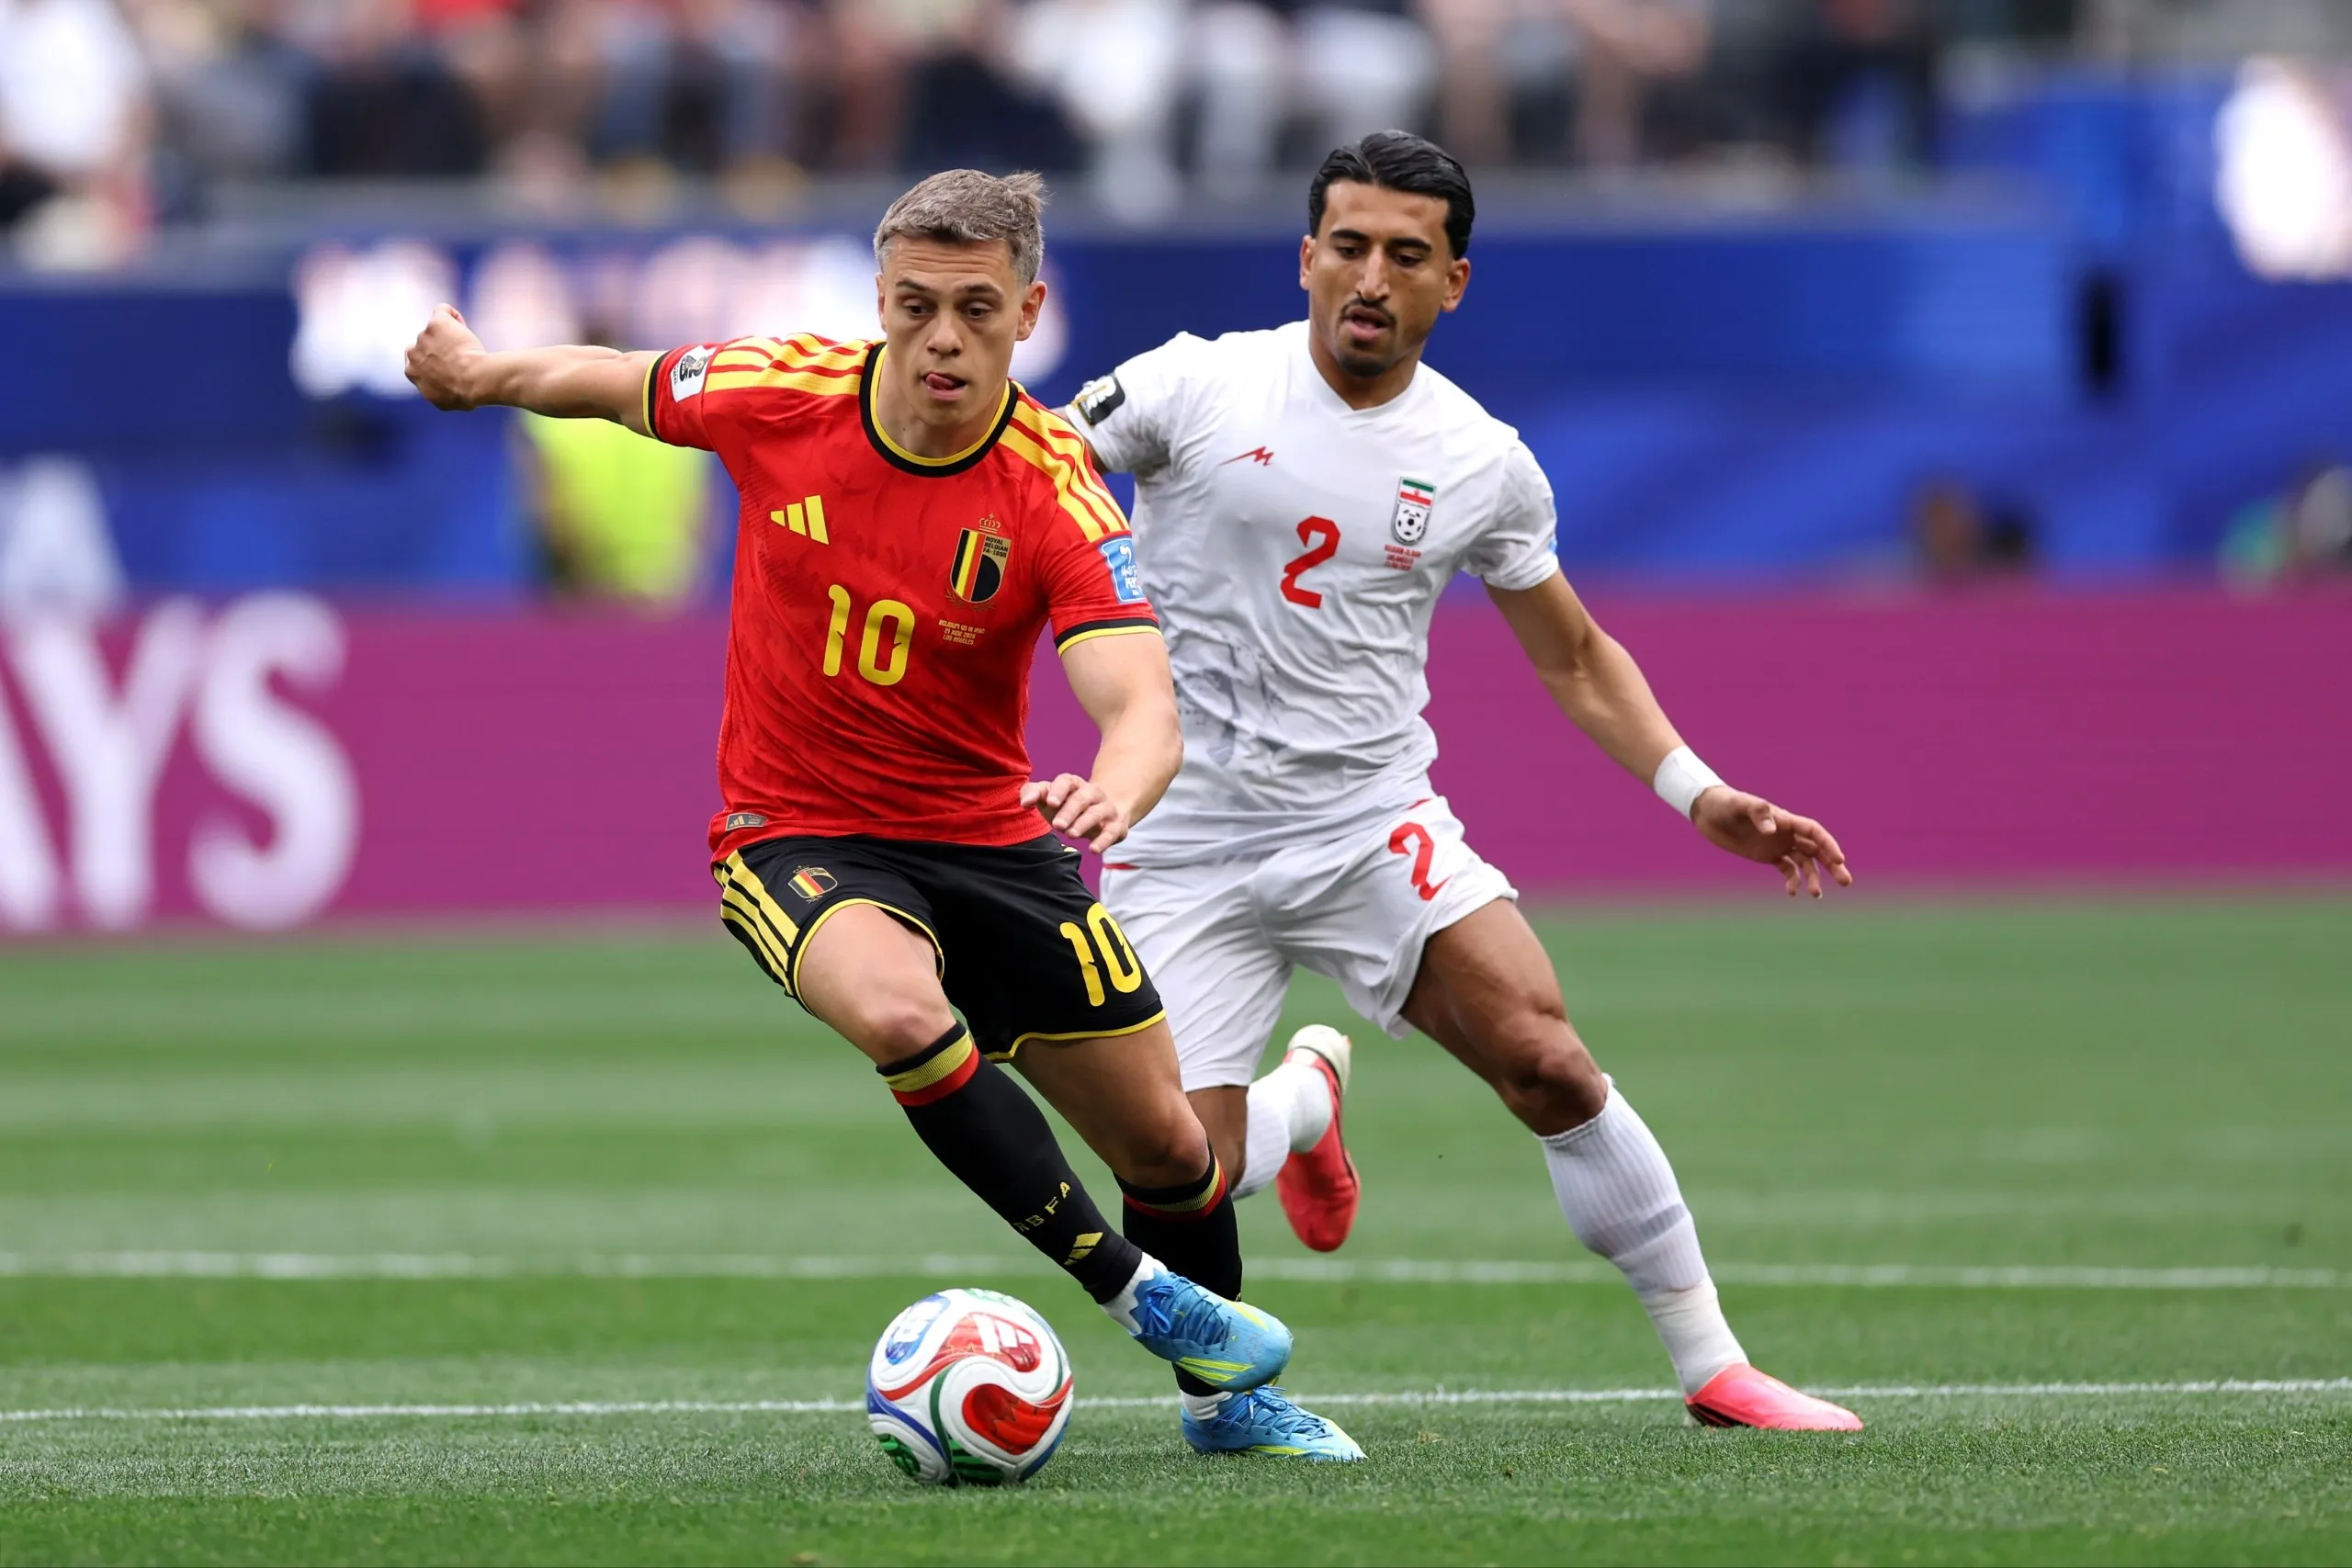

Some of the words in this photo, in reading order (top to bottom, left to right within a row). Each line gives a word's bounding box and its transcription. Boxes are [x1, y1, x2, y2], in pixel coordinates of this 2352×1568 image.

[984, 542, 1009, 552] BELGIAN
[986, 536, 1003, 545] ROYAL
[1280, 515, 1340, 609] 2
[823, 584, 915, 686] 10
[1387, 821, 1453, 902] 2
[1059, 902, 1142, 1007] 10
